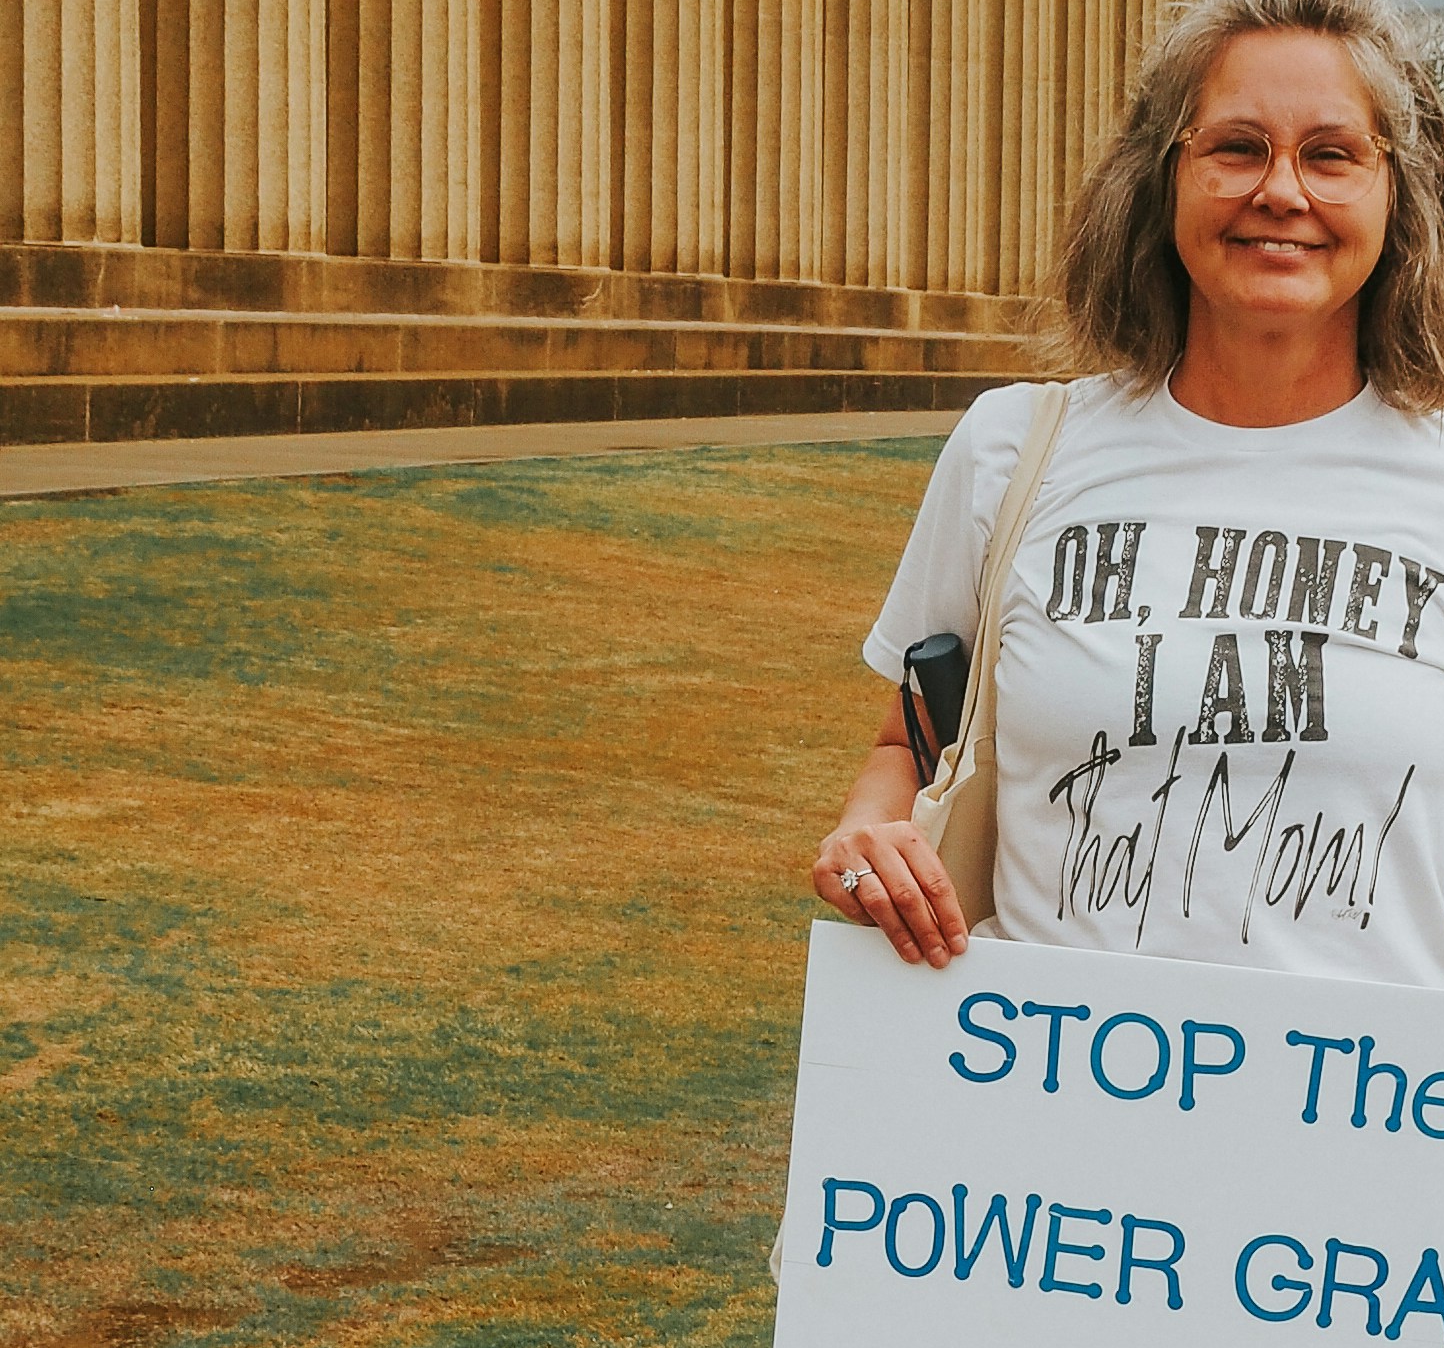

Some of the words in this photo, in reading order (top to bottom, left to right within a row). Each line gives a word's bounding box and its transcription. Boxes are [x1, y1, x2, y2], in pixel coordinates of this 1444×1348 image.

[1046, 522, 1152, 625] OH,
[1129, 633, 1163, 746] I
[1188, 630, 1330, 745] AM
[1049, 726, 1186, 949] That
[1183, 749, 1416, 945] Mom!
[948, 992, 1247, 1111] STOP
[816, 1176, 1187, 1311] POWER
